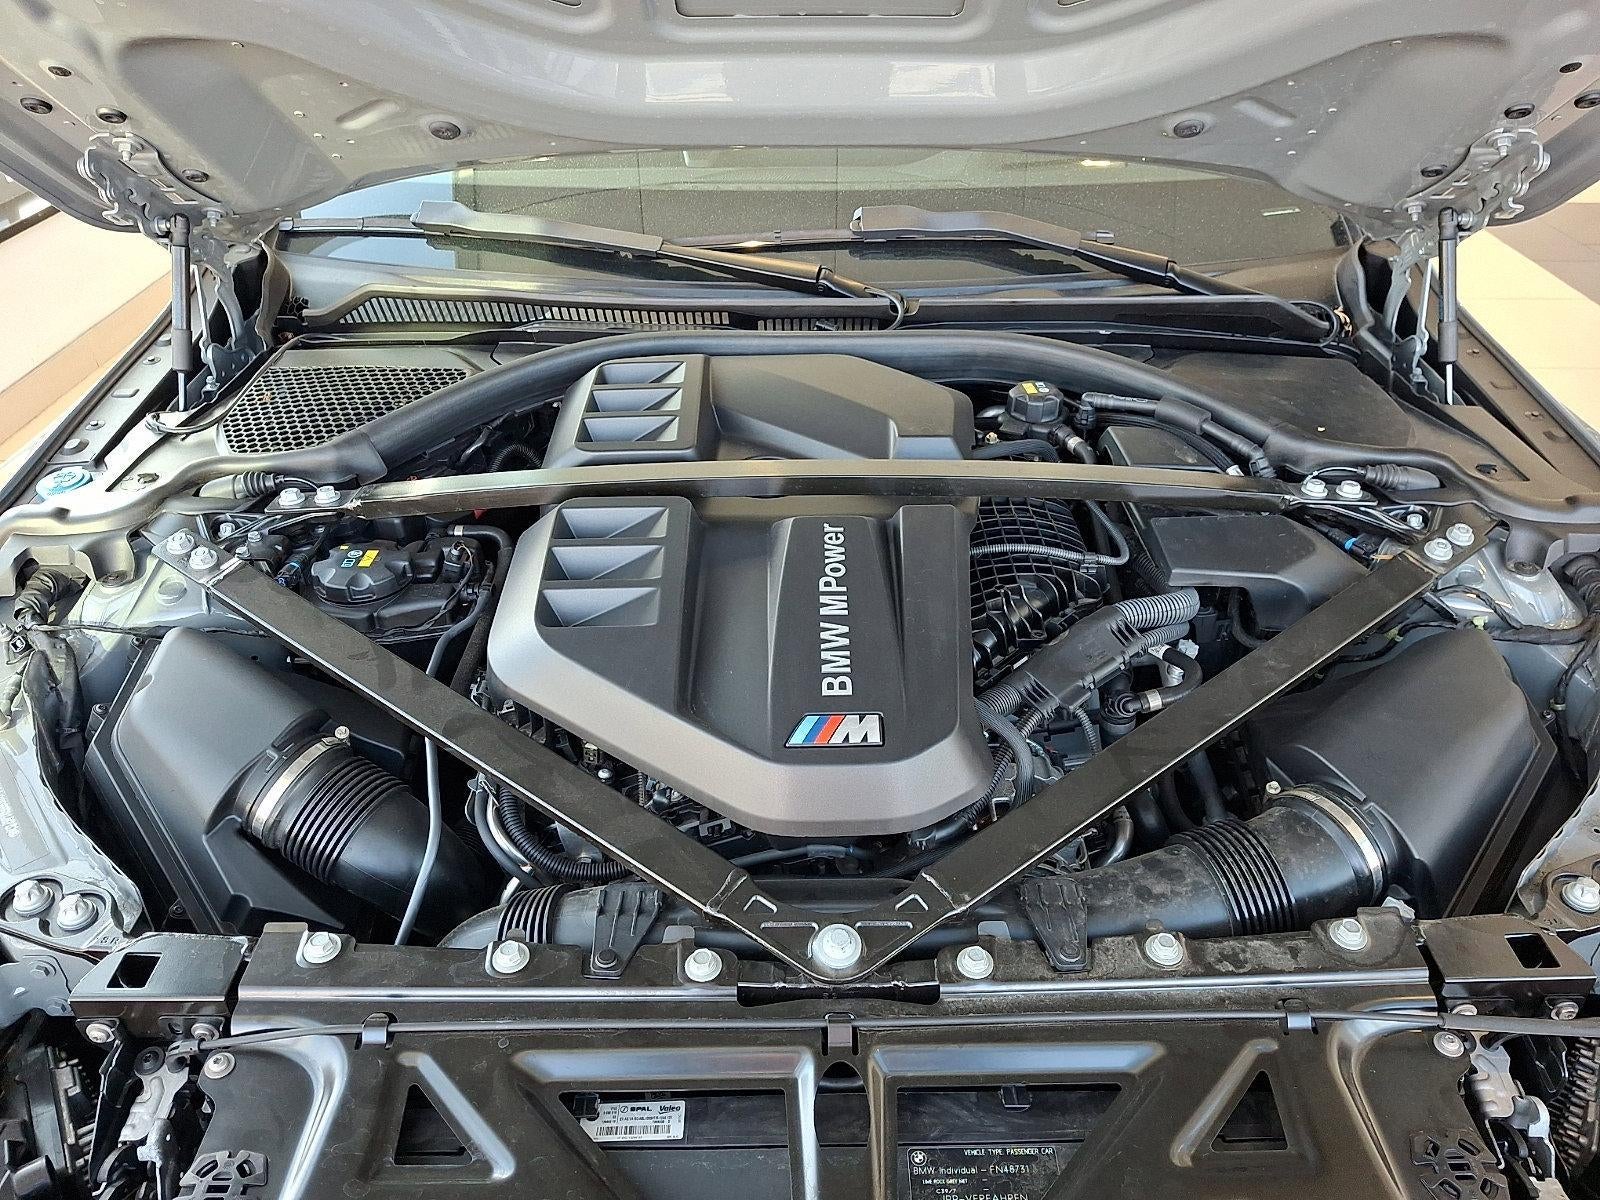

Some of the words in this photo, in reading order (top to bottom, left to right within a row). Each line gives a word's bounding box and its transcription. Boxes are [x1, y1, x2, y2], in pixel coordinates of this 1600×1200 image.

[819, 621, 853, 697] BMW
[828, 714, 882, 744] M
[964, 1148, 986, 1156] VEHICLE
[988, 1148, 1003, 1156] TYPE
[1006, 1147, 1039, 1155] PASSENGER
[1041, 1147, 1054, 1155] CAR
[913, 1166, 936, 1175] BMW
[938, 1165, 978, 1174] Individual
